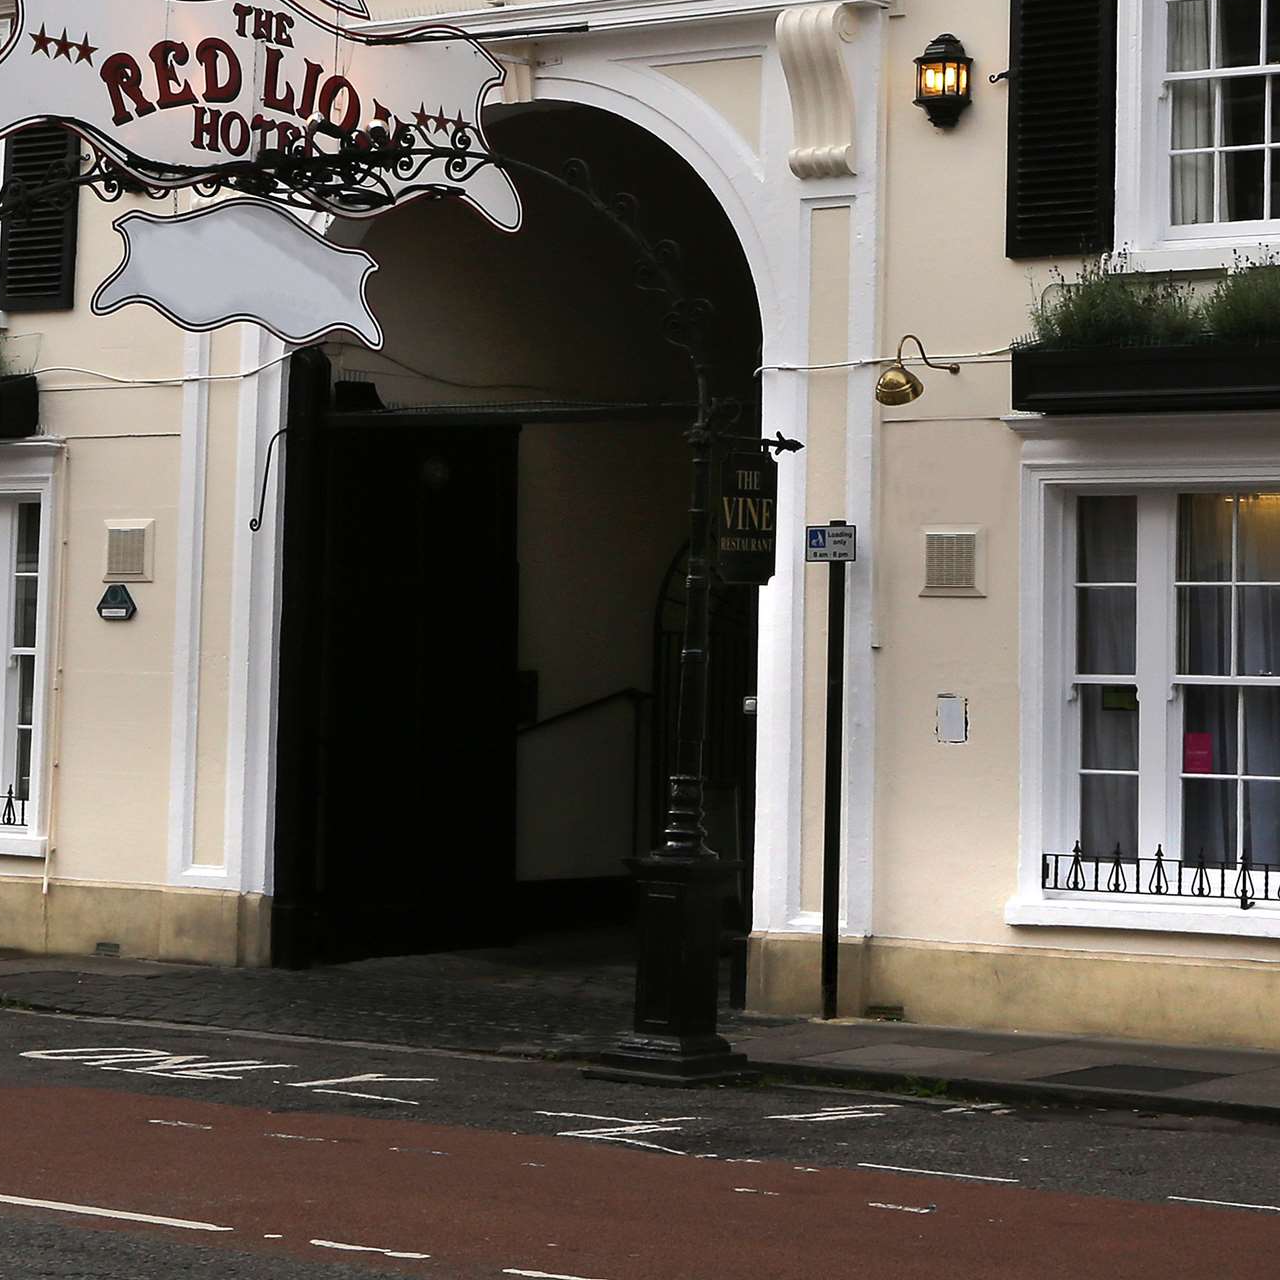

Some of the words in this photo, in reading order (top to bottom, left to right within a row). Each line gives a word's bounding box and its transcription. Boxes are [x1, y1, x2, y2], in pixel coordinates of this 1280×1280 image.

[232, 2, 295, 48] THE
[99, 36, 242, 127] RED
[736, 470, 761, 490] THE
[722, 496, 773, 531] VINE
[721, 536, 773, 552] RESTAURANT
[17, 1047, 438, 1087] ONLY
